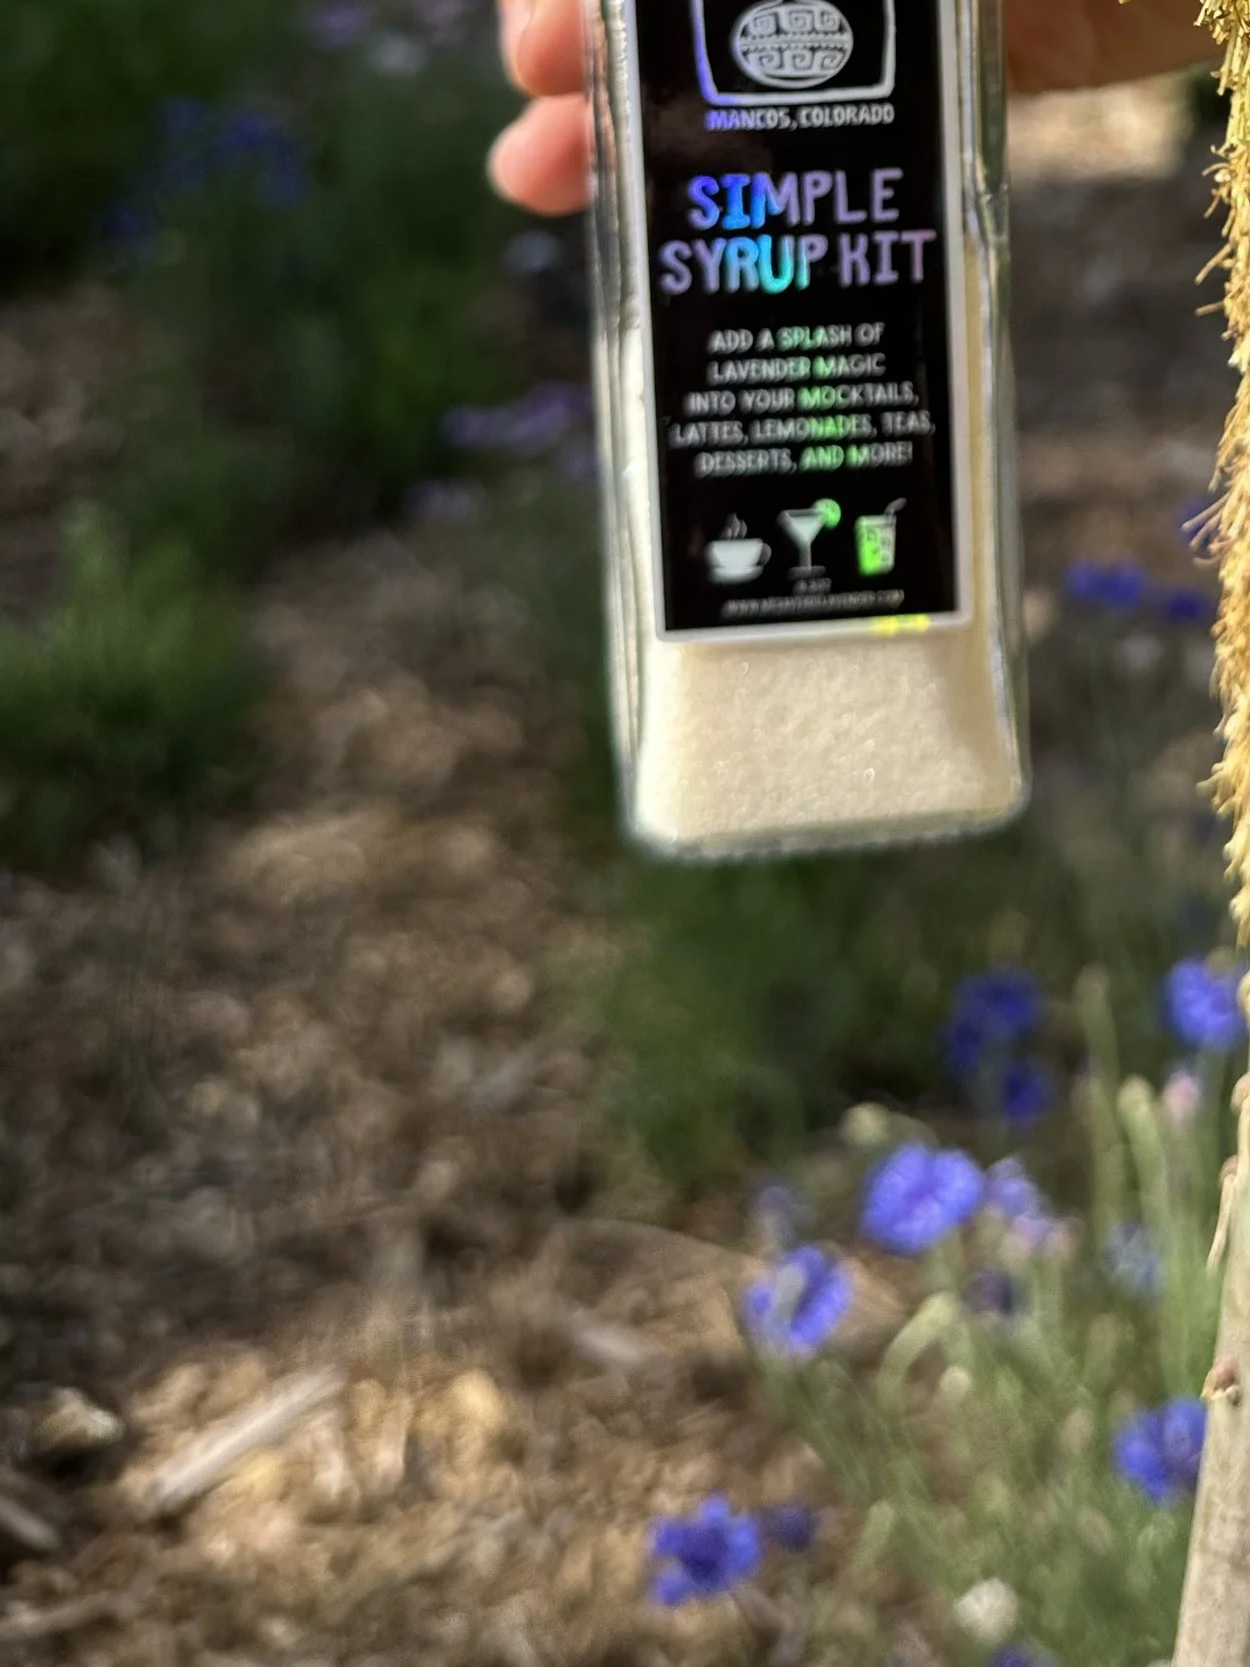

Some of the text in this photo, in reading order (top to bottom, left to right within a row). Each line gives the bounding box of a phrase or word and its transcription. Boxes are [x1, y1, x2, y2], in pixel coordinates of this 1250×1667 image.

[705, 102, 895, 131] MANCOS, COLORADO
[687, 166, 904, 231] SIMPLE
[658, 228, 938, 295] SYRUP KIT
[708, 321, 885, 354] ADD A SPLASH OF
[706, 352, 887, 384] LAVENDER MAGIC
[683, 389, 736, 417] INTO
[737, 386, 796, 414] YOUR
[694, 447, 797, 478] DESSERTS,
[798, 444, 845, 471] AND
